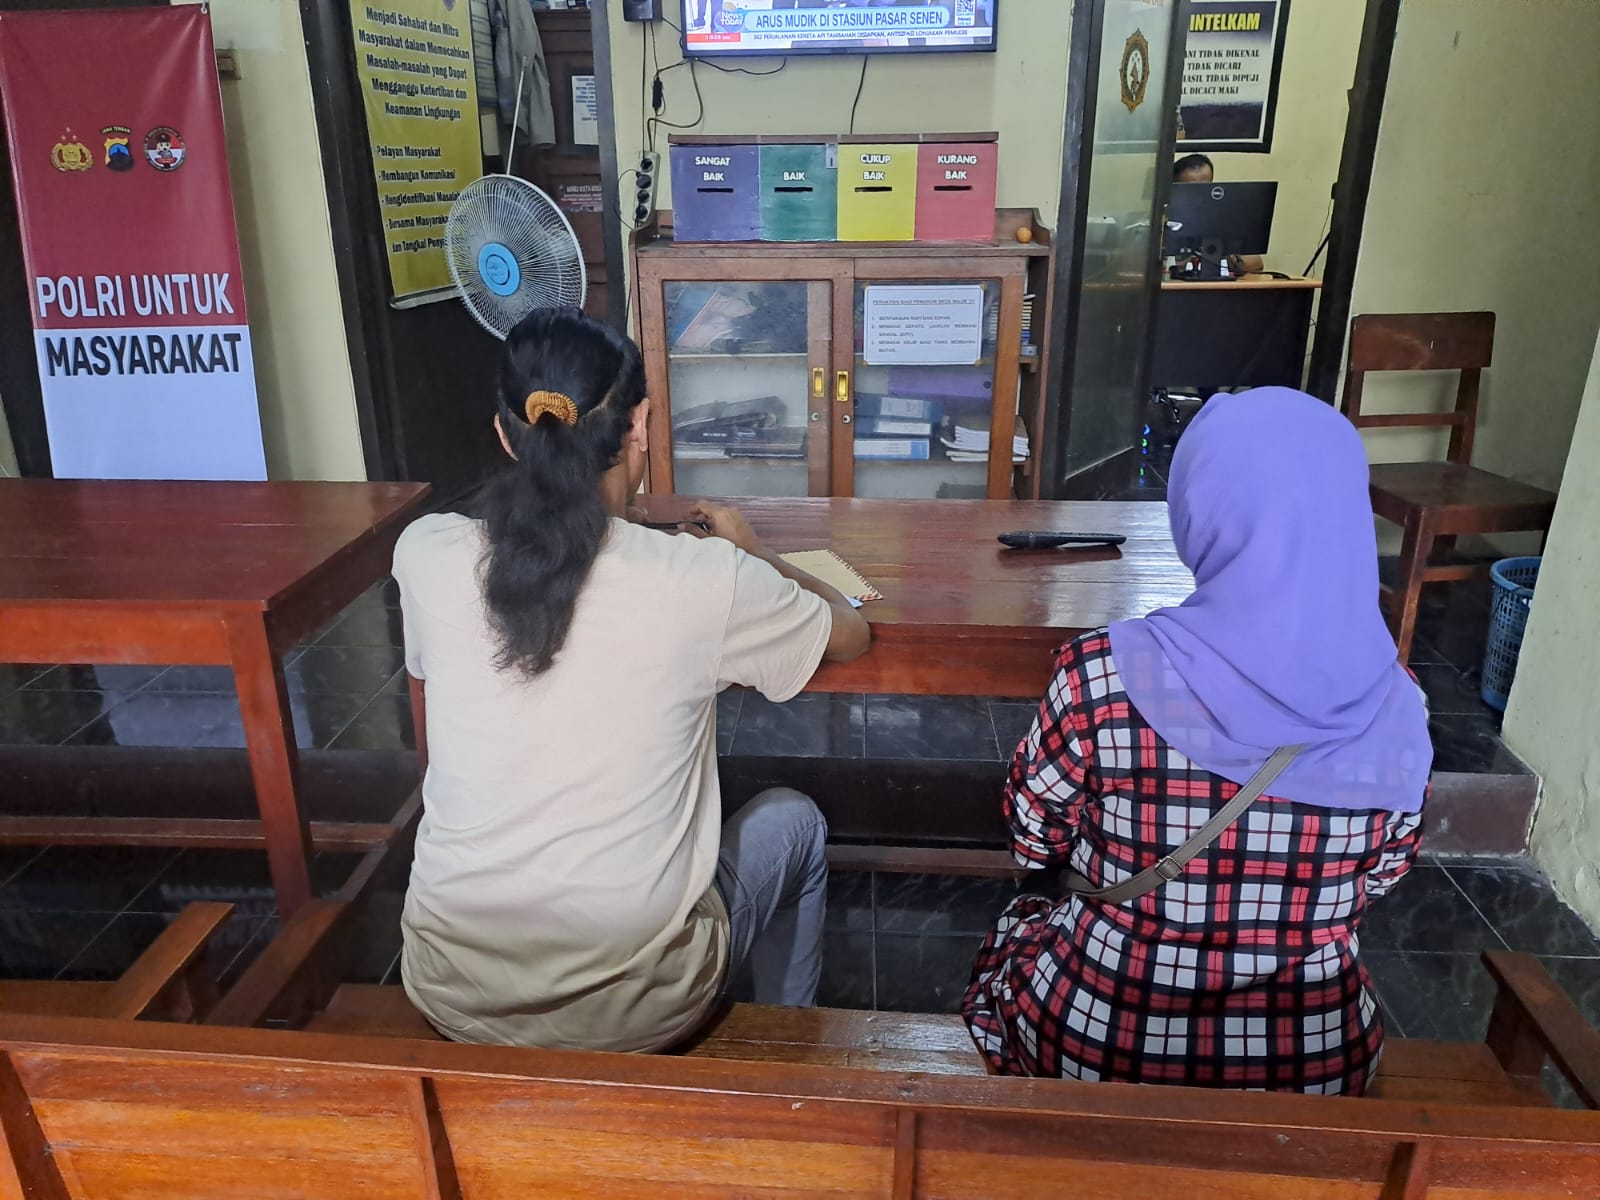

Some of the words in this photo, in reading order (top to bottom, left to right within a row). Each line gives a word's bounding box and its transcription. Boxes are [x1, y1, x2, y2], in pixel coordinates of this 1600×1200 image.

[366, 6, 397, 25] Menjadi
[398, 14, 428, 31] Sahabat
[429, 20, 441, 33] dan
[442, 23, 459, 37] Mitra
[756, 15, 783, 28] ARUS
[785, 14, 817, 27] MUDIK
[820, 14, 829, 26] DI
[832, 12, 873, 27] STASIUN
[875, 11, 907, 26] PASAR
[909, 11, 943, 25] SENEN
[1189, 12, 1261, 32] INTELKAM
[826, 31, 856, 39] TAMBAHAN
[358, 29, 403, 48] Masyarakat
[405, 38, 426, 52] dalam
[427, 41, 470, 59] Memecahkan
[1199, 50, 1224, 58] TIDAK
[1225, 49, 1260, 58] DIKENAL
[366, 54, 431, 74] Masalah-masalah
[432, 65, 447, 79] yang
[448, 66, 467, 79] Dapat
[1187, 62, 1212, 71] TIDAK
[1213, 62, 1241, 70] DICARI
[1206, 74, 1230, 83] TIDAK
[1232, 74, 1259, 82] DIPUJI
[372, 78, 419, 96] Mengganggu
[420, 83, 454, 98] Ketertiban
[455, 88, 467, 99] dan
[1189, 87, 1216, 96] DICACI
[1218, 86, 1239, 95] MAKI
[385, 102, 423, 117] Keamanan
[424, 105, 461, 121] Lingkungan
[404, 146, 442, 158] Masyarakat
[695, 156, 731, 166] SANGAT
[860, 154, 891, 164] CUKUP
[937, 155, 977, 164] KURANG
[420, 169, 455, 180] Komunikasi
[703, 172, 724, 181] BAIK
[783, 171, 806, 181] BAIK
[863, 171, 885, 181] BAIK
[945, 171, 967, 180] BAIK
[416, 215, 449, 228] Masyaraka
[403, 239, 426, 252] Tangkal
[36, 274, 126, 318] POLRI
[131, 273, 234, 315] UNTUK
[45, 332, 242, 377] MASYARAKAT
